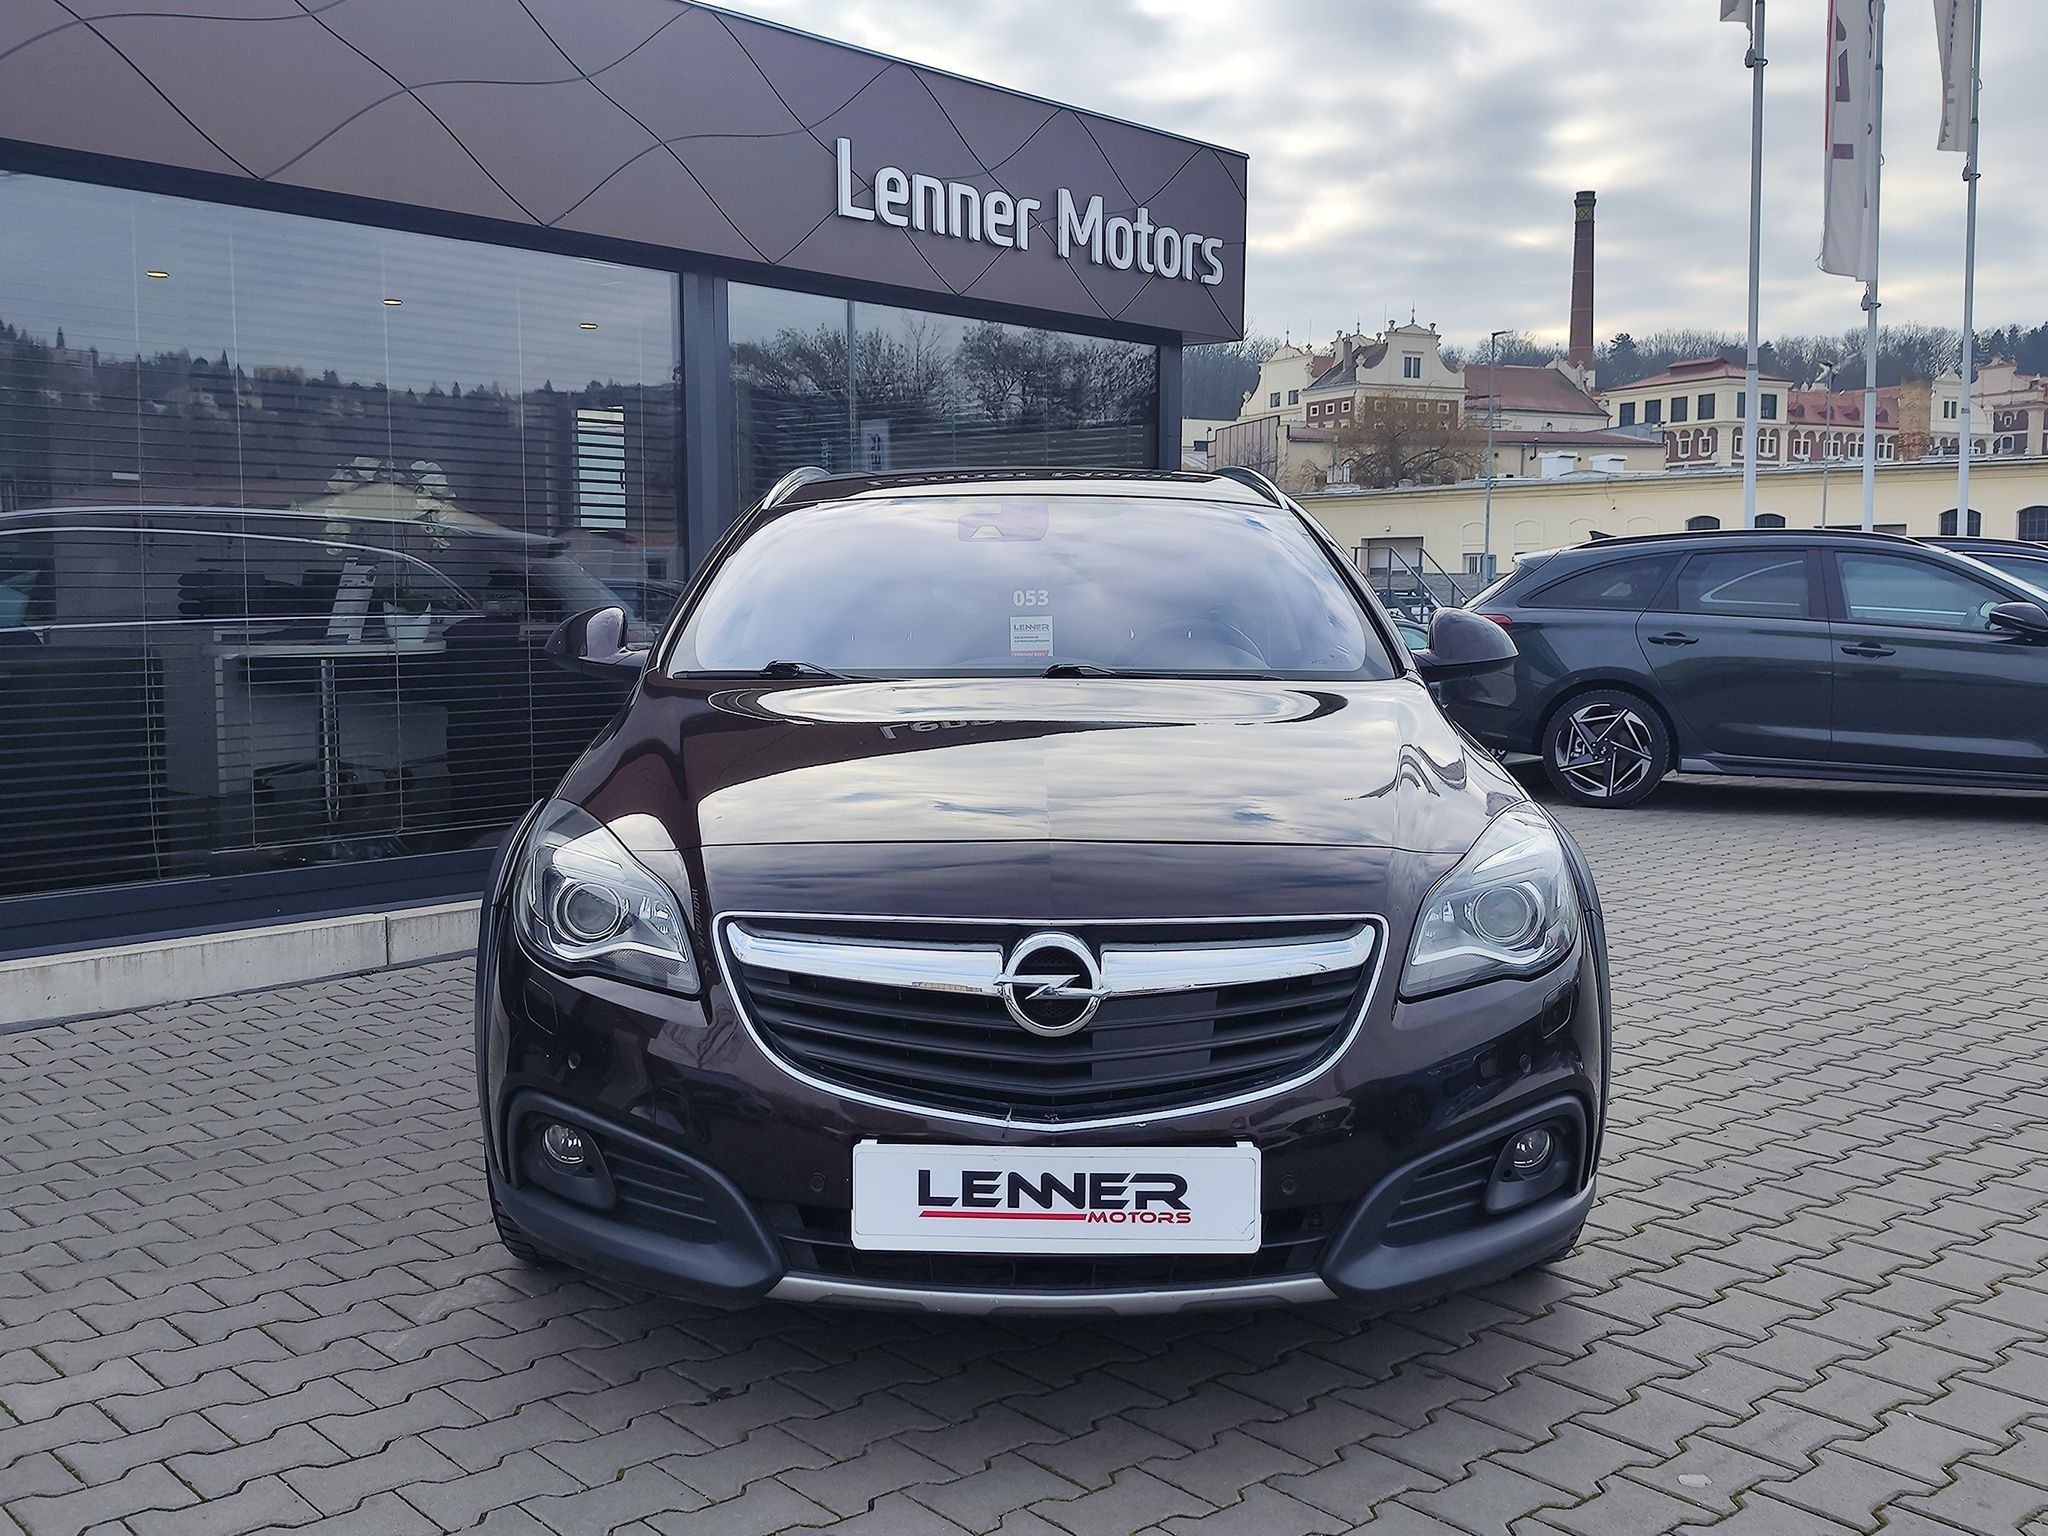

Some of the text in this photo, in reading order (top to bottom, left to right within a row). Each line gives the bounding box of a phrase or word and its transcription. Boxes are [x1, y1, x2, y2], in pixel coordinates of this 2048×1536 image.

[836, 137, 1225, 285] Lenner Motors
[1012, 590, 1049, 606] 053
[1013, 623, 1050, 632] LENNER
[918, 1169, 1191, 1211] LENNER
[1087, 1211, 1191, 1224] MOTORS
